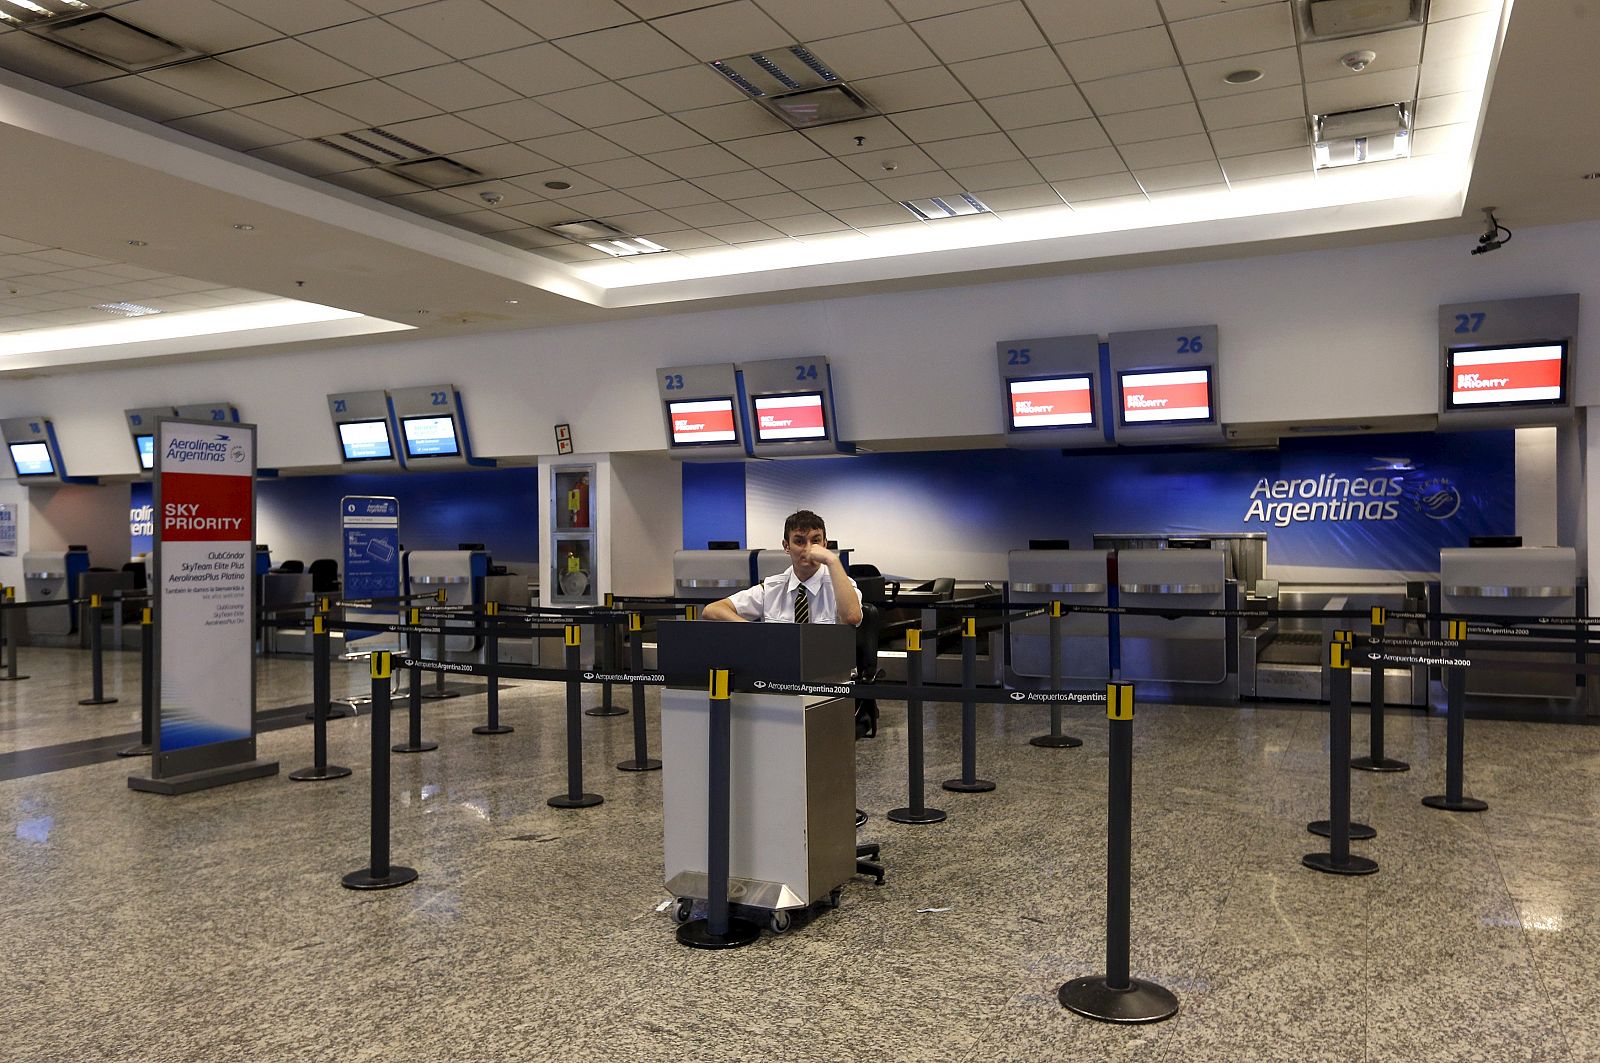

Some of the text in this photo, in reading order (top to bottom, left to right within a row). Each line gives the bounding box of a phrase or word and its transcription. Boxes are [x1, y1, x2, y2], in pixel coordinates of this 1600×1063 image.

[1454, 312, 1486, 334] 27
[1177, 336, 1203, 354] 26
[1007, 349, 1030, 365] 25
[795, 365, 818, 381] 24
[665, 375, 684, 390] 23
[431, 392, 448, 405] 22
[334, 399, 348, 412] 21
[211, 410, 225, 421] 20
[169, 438, 228, 452] Aerolíneas
[166, 449, 226, 462] Argentinas
[1249, 473, 1404, 499] Aerolíneas
[165, 503, 200, 516] SKY
[1243, 498, 1400, 528] Argentinas
[165, 517, 242, 529] PRIORITY
[181, 561, 245, 572] SkyTeam Elite Plus
[221, 572, 245, 580] Platino
[1412, 639, 1444, 647] Argentina
[1383, 653, 1418, 663] Aeropuertos
[1418, 656, 1454, 665] Argentina
[437, 662, 461, 671] Argentina
[595, 672, 665, 683] Aeropuertos Argentina 2000
[768, 681, 850, 694] Aeropuertos Argentina 2000
[1027, 692, 1107, 703] Aeropuertos Argentina
